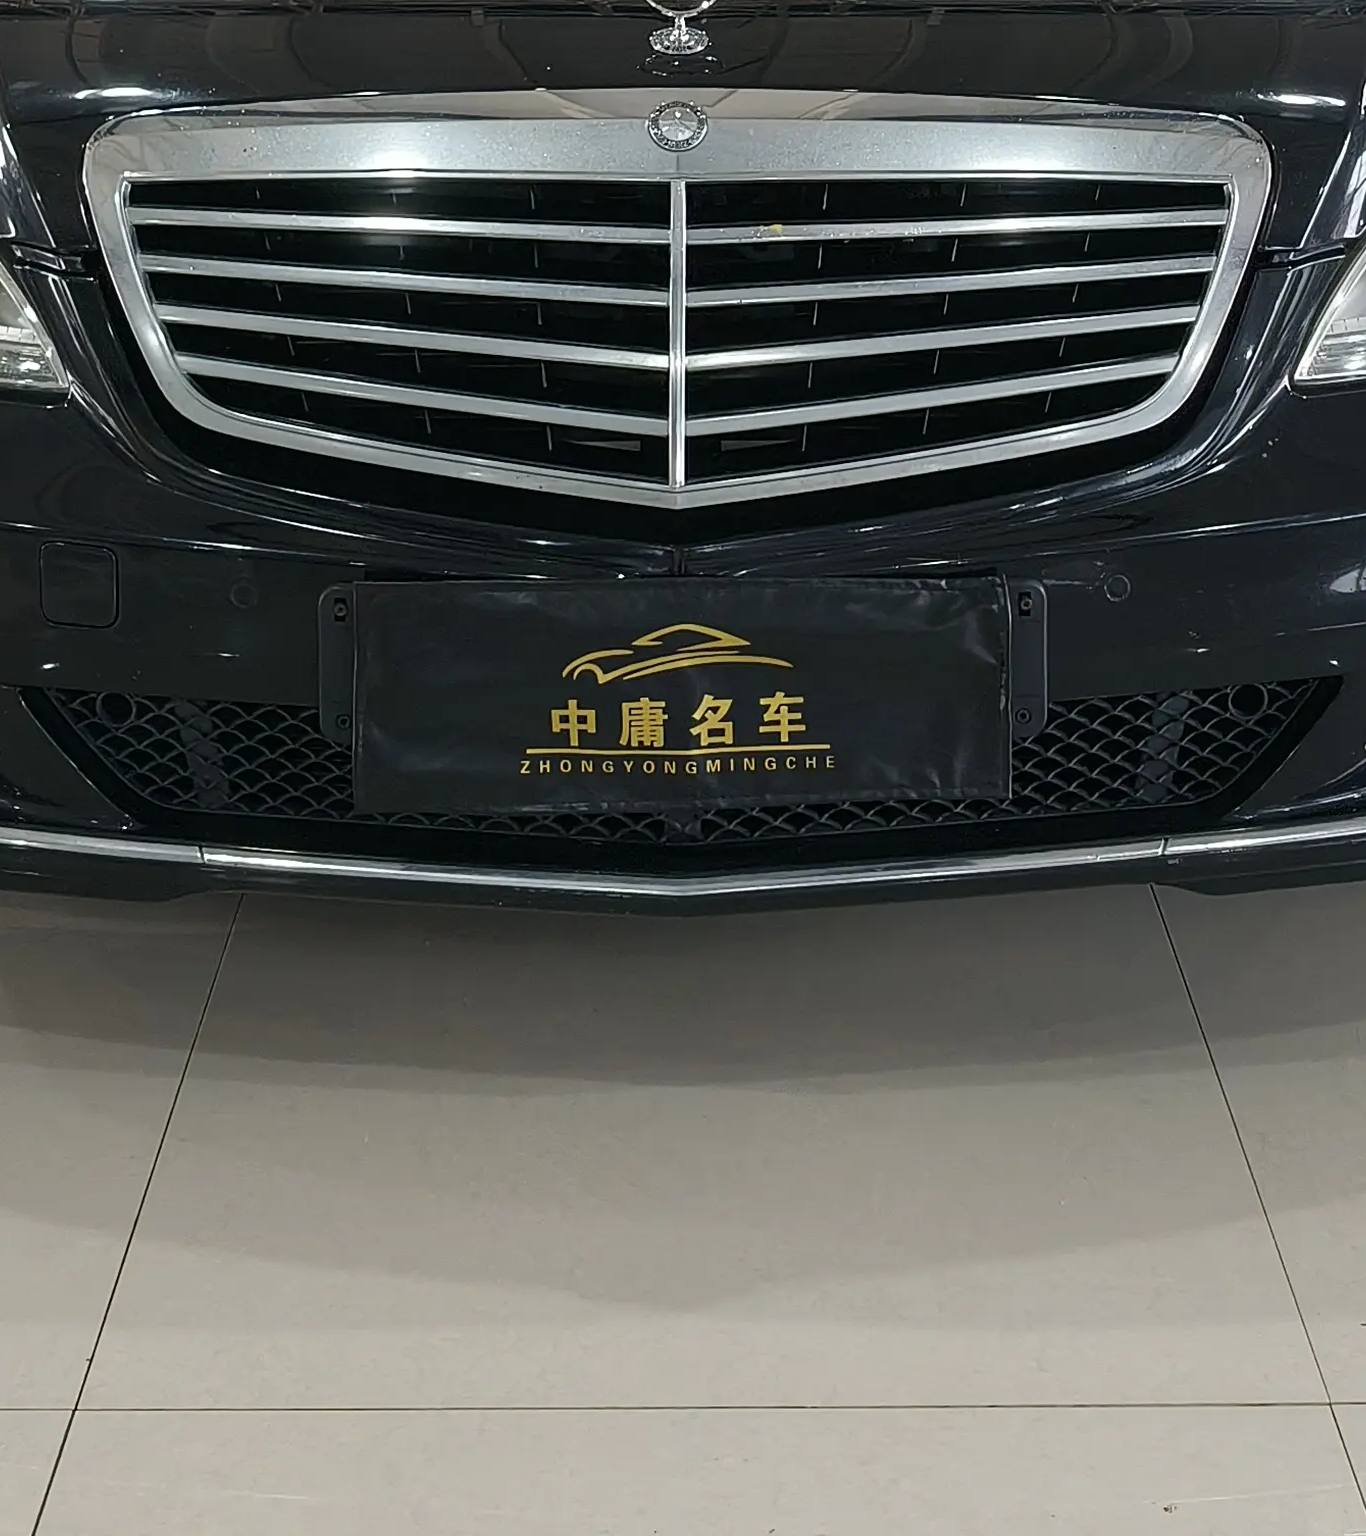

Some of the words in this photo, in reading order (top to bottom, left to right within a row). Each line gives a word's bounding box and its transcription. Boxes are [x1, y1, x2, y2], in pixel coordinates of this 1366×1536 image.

[550, 691, 808, 748] 中庸名车
[519, 754, 836, 775] ZHONGYONGMINGCHE
